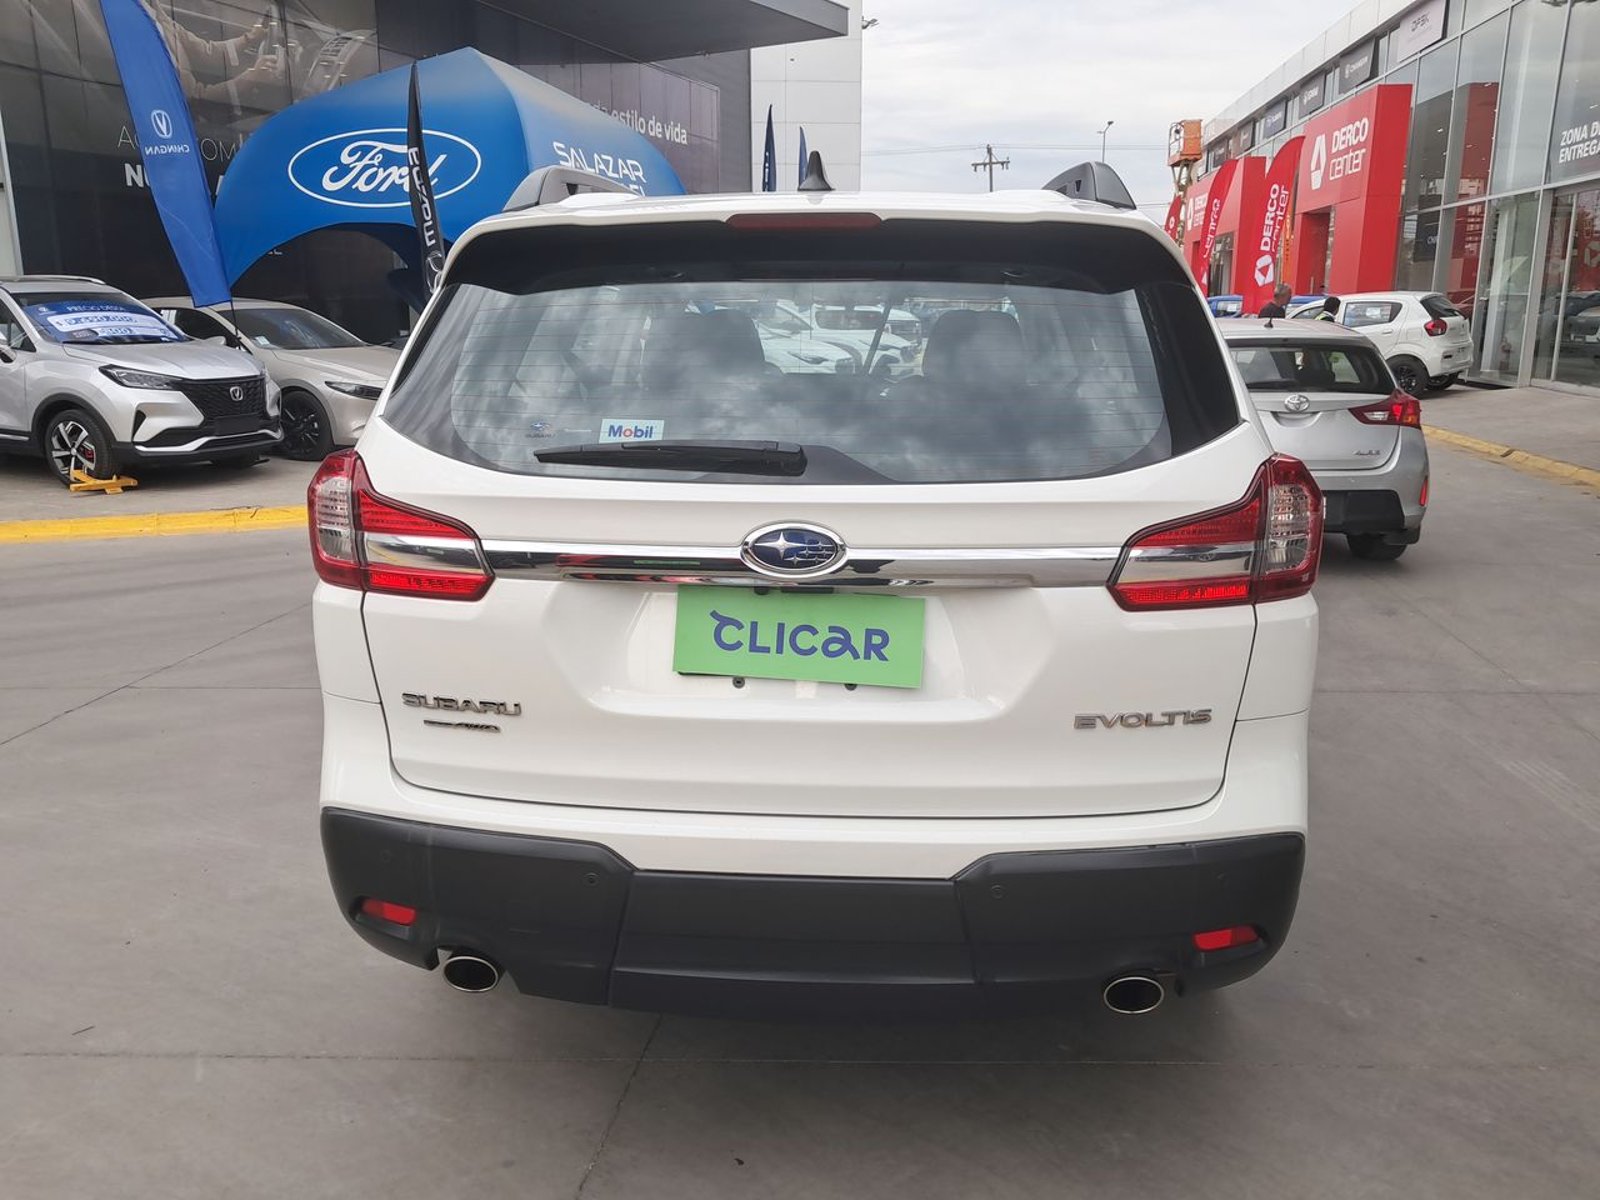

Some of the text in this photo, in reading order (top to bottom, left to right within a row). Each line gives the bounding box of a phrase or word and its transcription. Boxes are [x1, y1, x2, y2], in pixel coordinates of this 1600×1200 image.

[648, 115, 662, 138] de
[664, 121, 688, 145] vida
[1332, 117, 1369, 154] DERCO
[1560, 121, 1600, 146] ZONA D
[553, 141, 647, 184] SALAZAR
[1260, 183, 1280, 251] DERCO
[608, 424, 654, 439] Mobil
[402, 693, 522, 717] SUBARU
[1074, 708, 1213, 730] EVOLTIS
